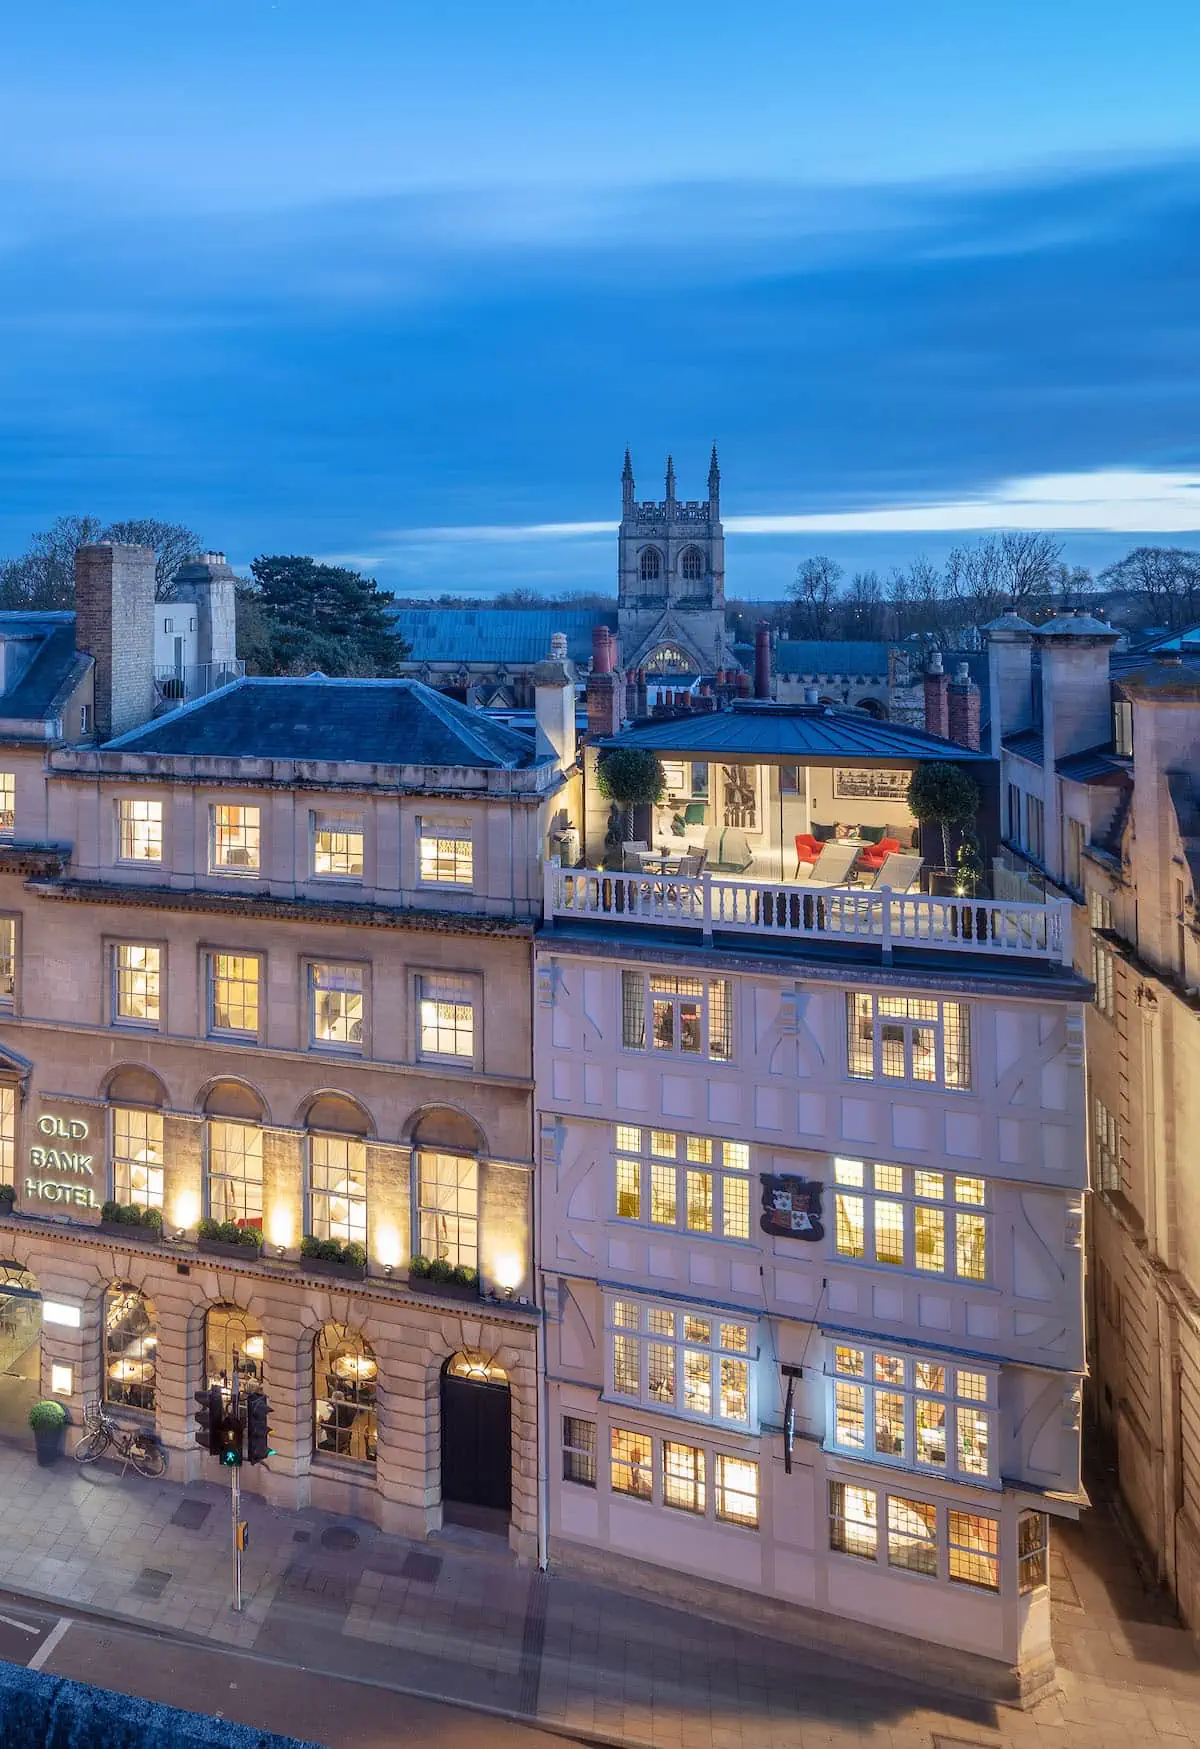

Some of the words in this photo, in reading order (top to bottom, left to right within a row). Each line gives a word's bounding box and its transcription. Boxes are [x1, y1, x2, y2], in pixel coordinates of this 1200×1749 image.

[38, 1115, 88, 1140] OLD
[30, 1147, 94, 1176] BANK
[24, 1178, 101, 1210] HOTEL
